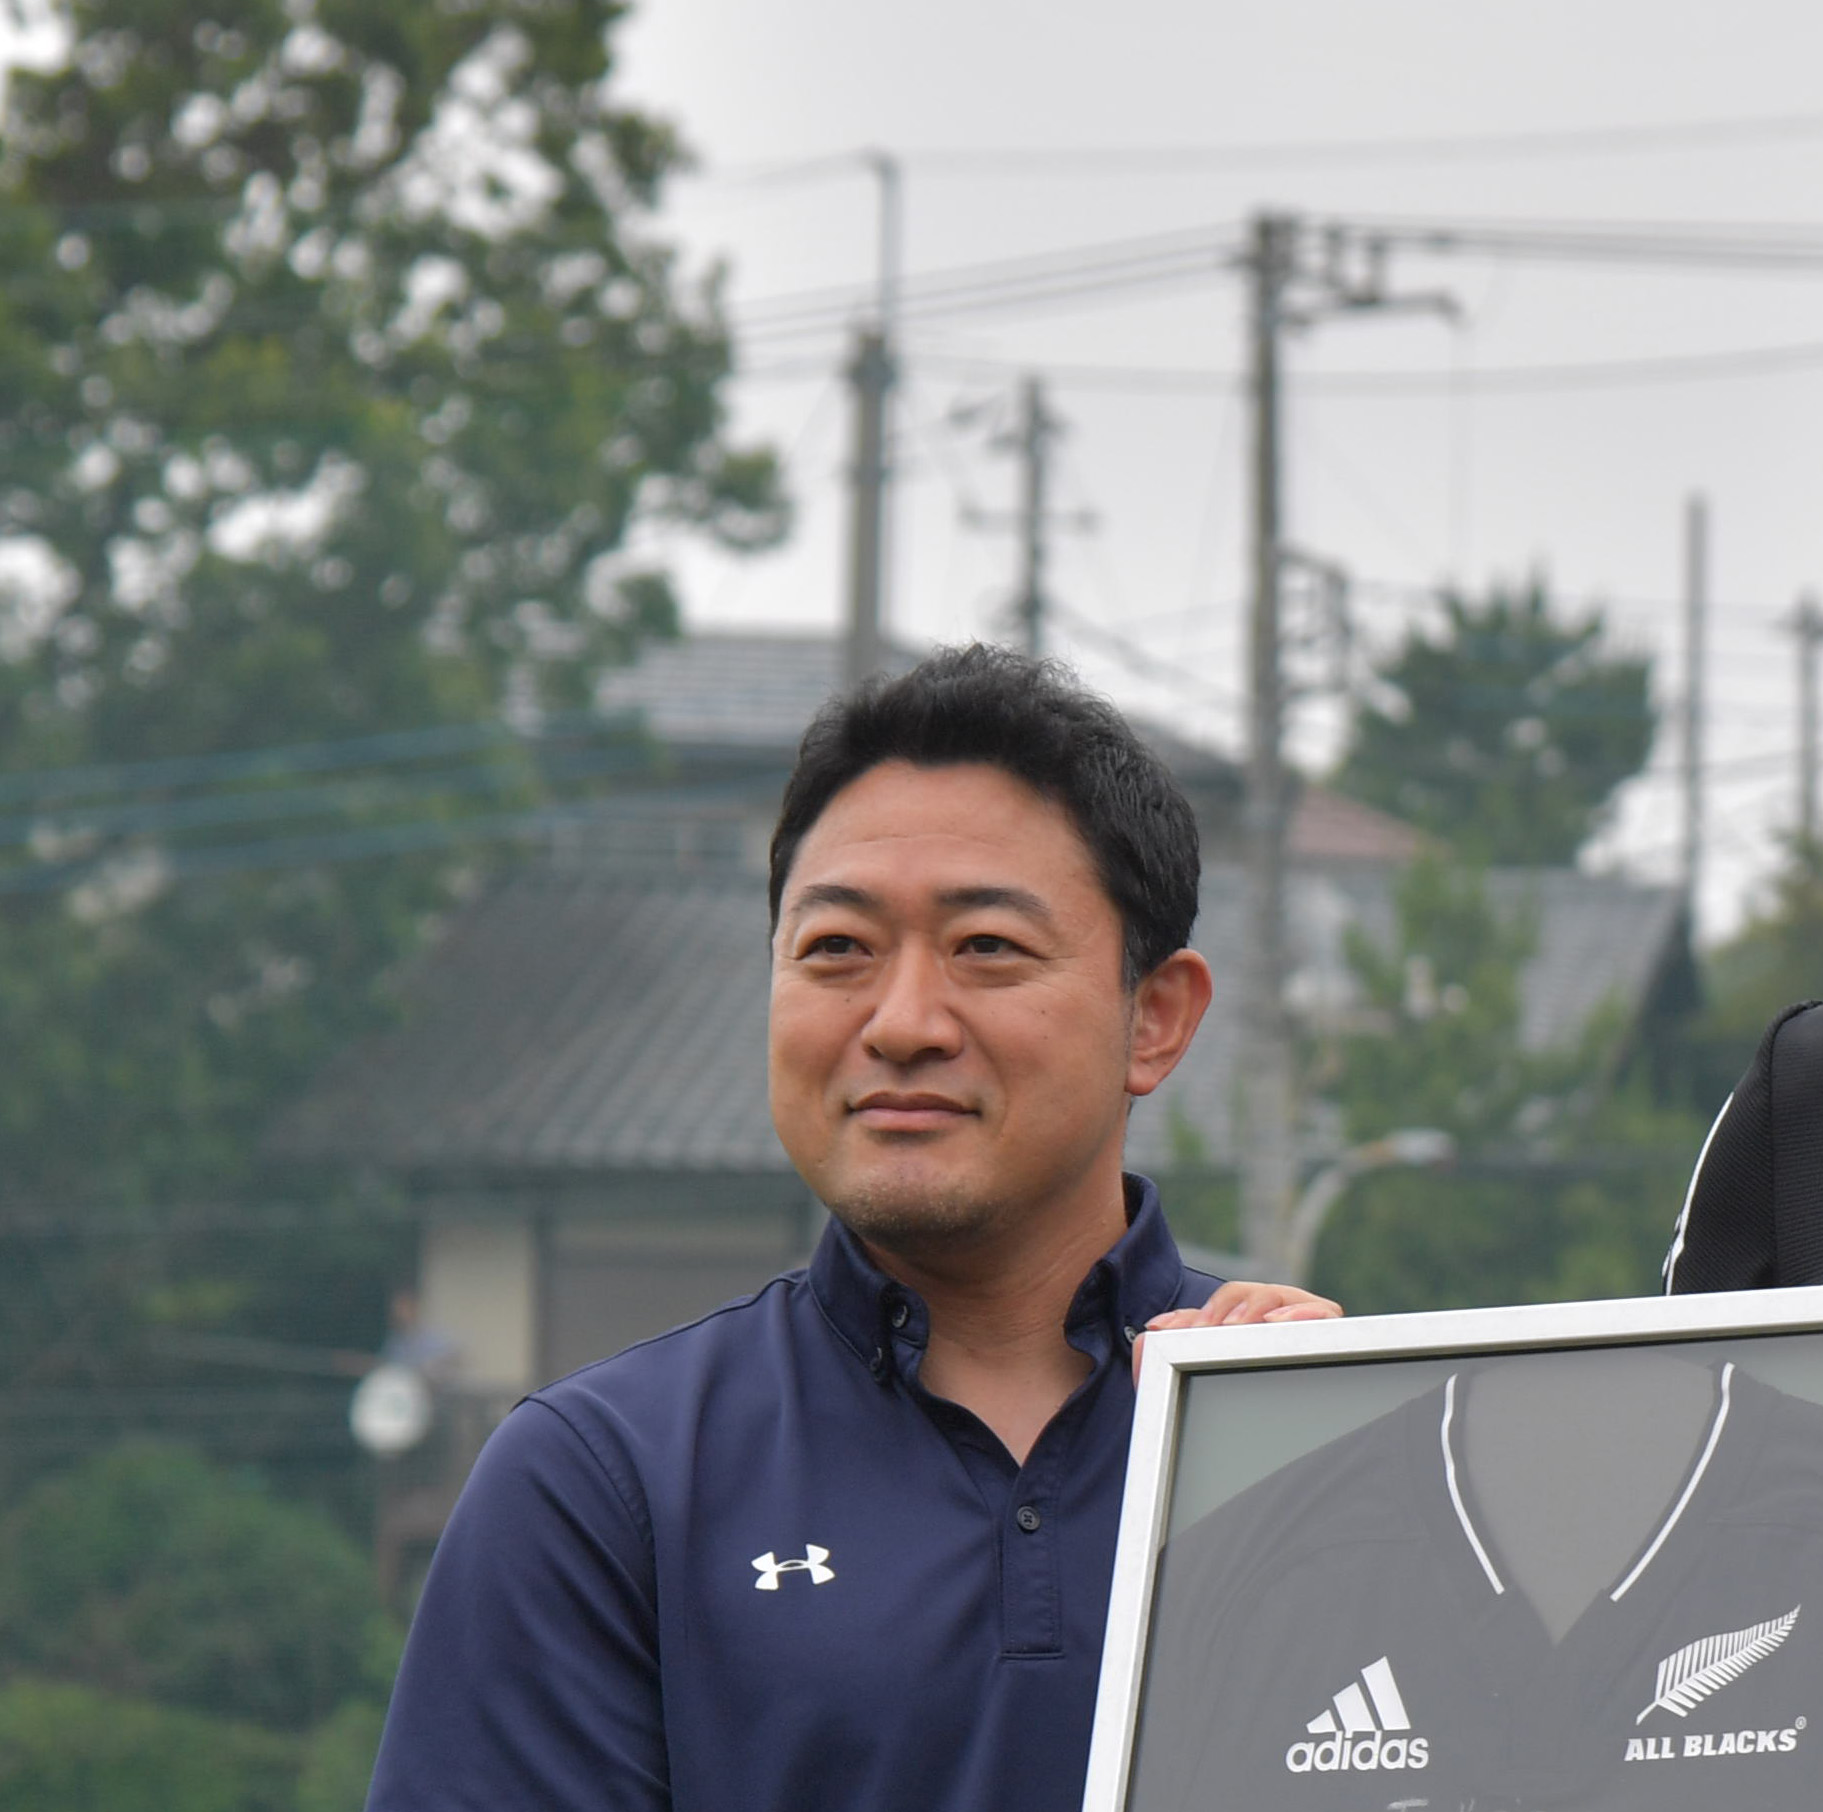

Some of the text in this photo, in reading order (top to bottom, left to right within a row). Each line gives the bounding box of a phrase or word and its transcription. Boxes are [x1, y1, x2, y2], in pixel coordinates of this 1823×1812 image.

[1286, 1731, 1428, 1772] adidas
[1624, 1727, 1797, 1761] ALL BLACKS
